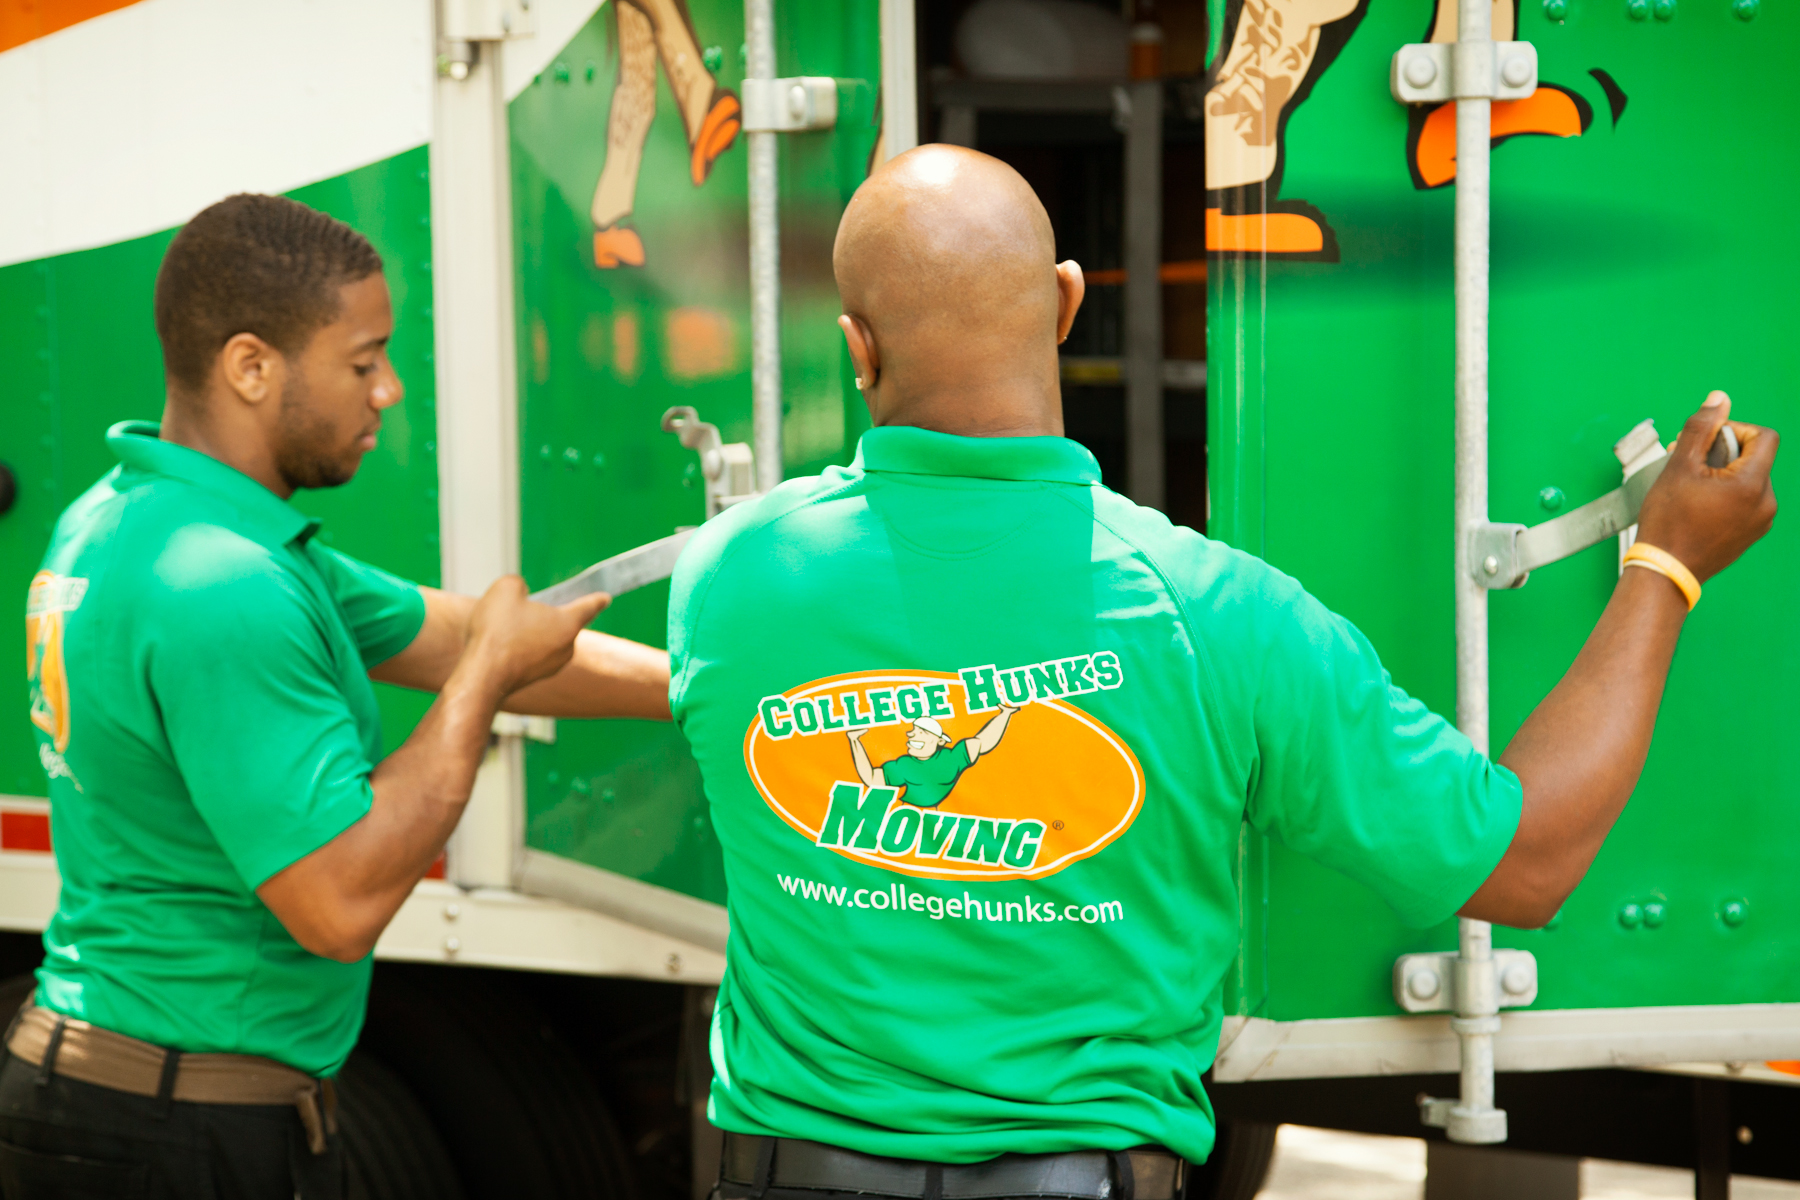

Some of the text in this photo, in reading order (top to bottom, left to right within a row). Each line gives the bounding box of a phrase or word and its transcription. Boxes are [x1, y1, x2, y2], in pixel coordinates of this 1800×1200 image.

[759, 652, 1123, 740] COLLEGE HUNKS
[818, 782, 1046, 868] MOVING
[777, 874, 1124, 923] www.collegehunks.com
